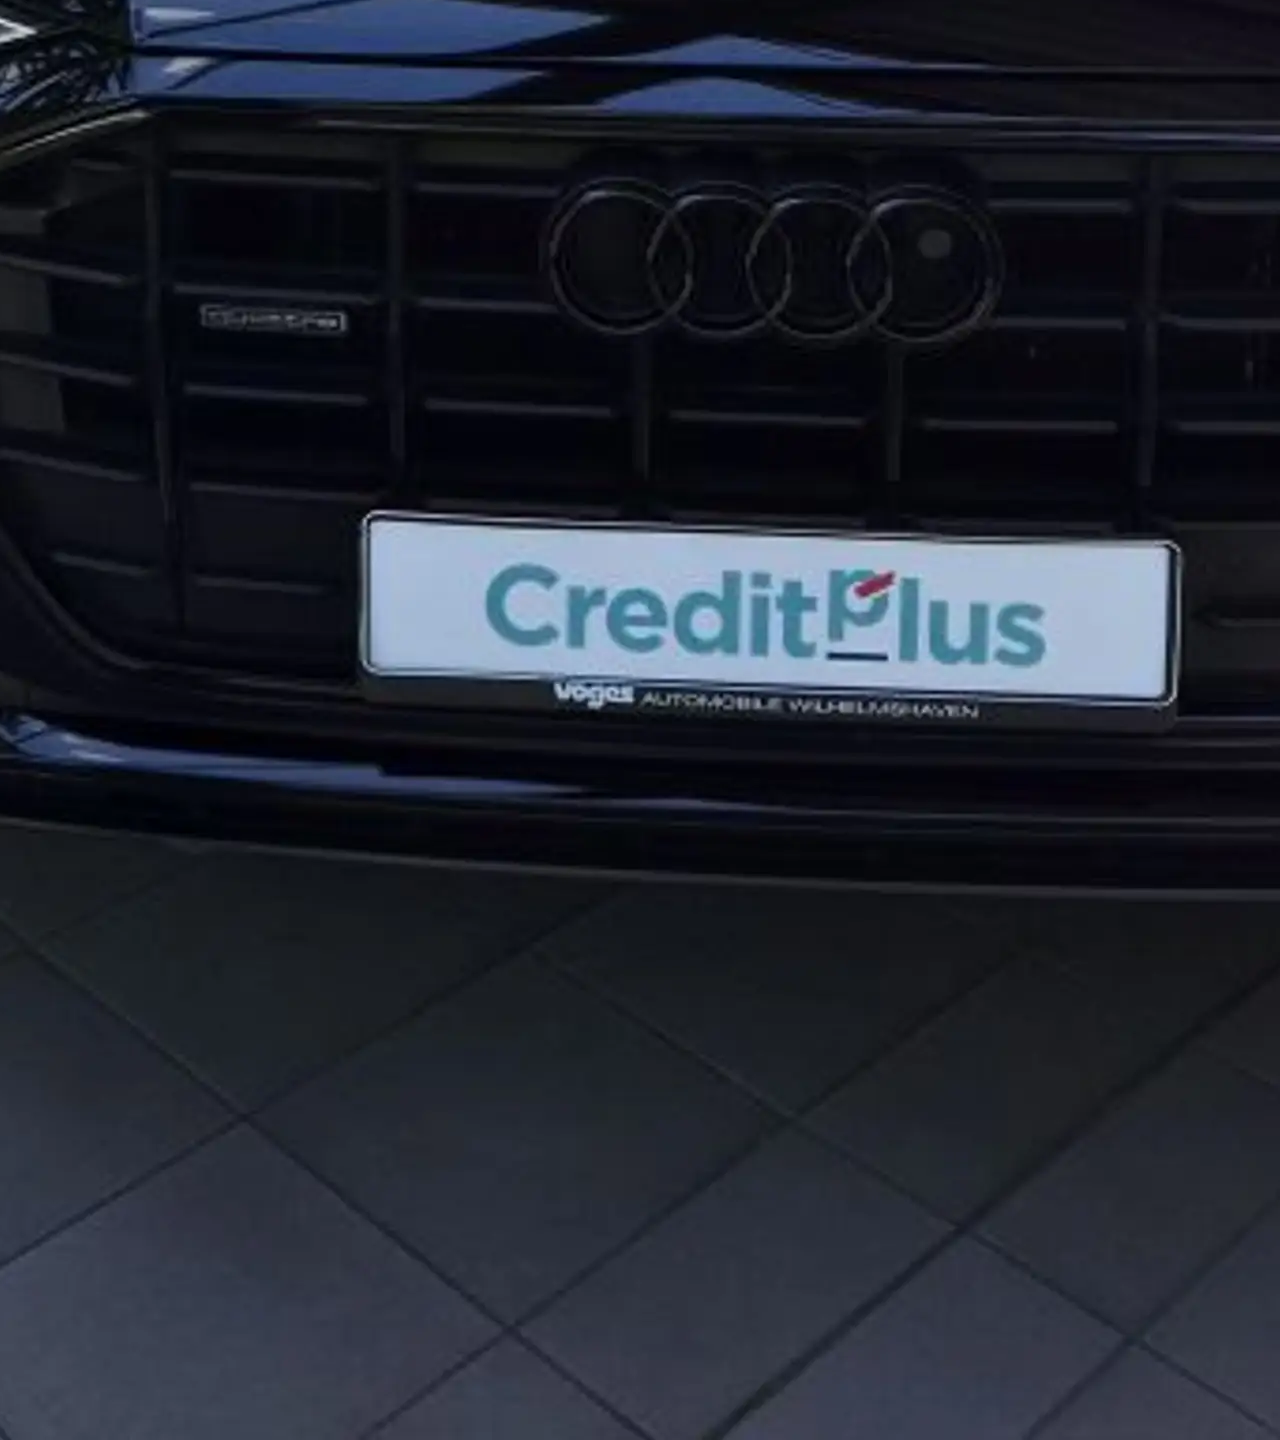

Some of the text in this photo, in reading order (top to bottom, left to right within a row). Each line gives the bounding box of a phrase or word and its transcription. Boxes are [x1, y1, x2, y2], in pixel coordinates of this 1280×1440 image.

[484, 563, 1047, 667] CreditPlus
[640, 691, 782, 711] AUTOMOBILE
[788, 697, 979, 719] WILHELMSHAVEN
